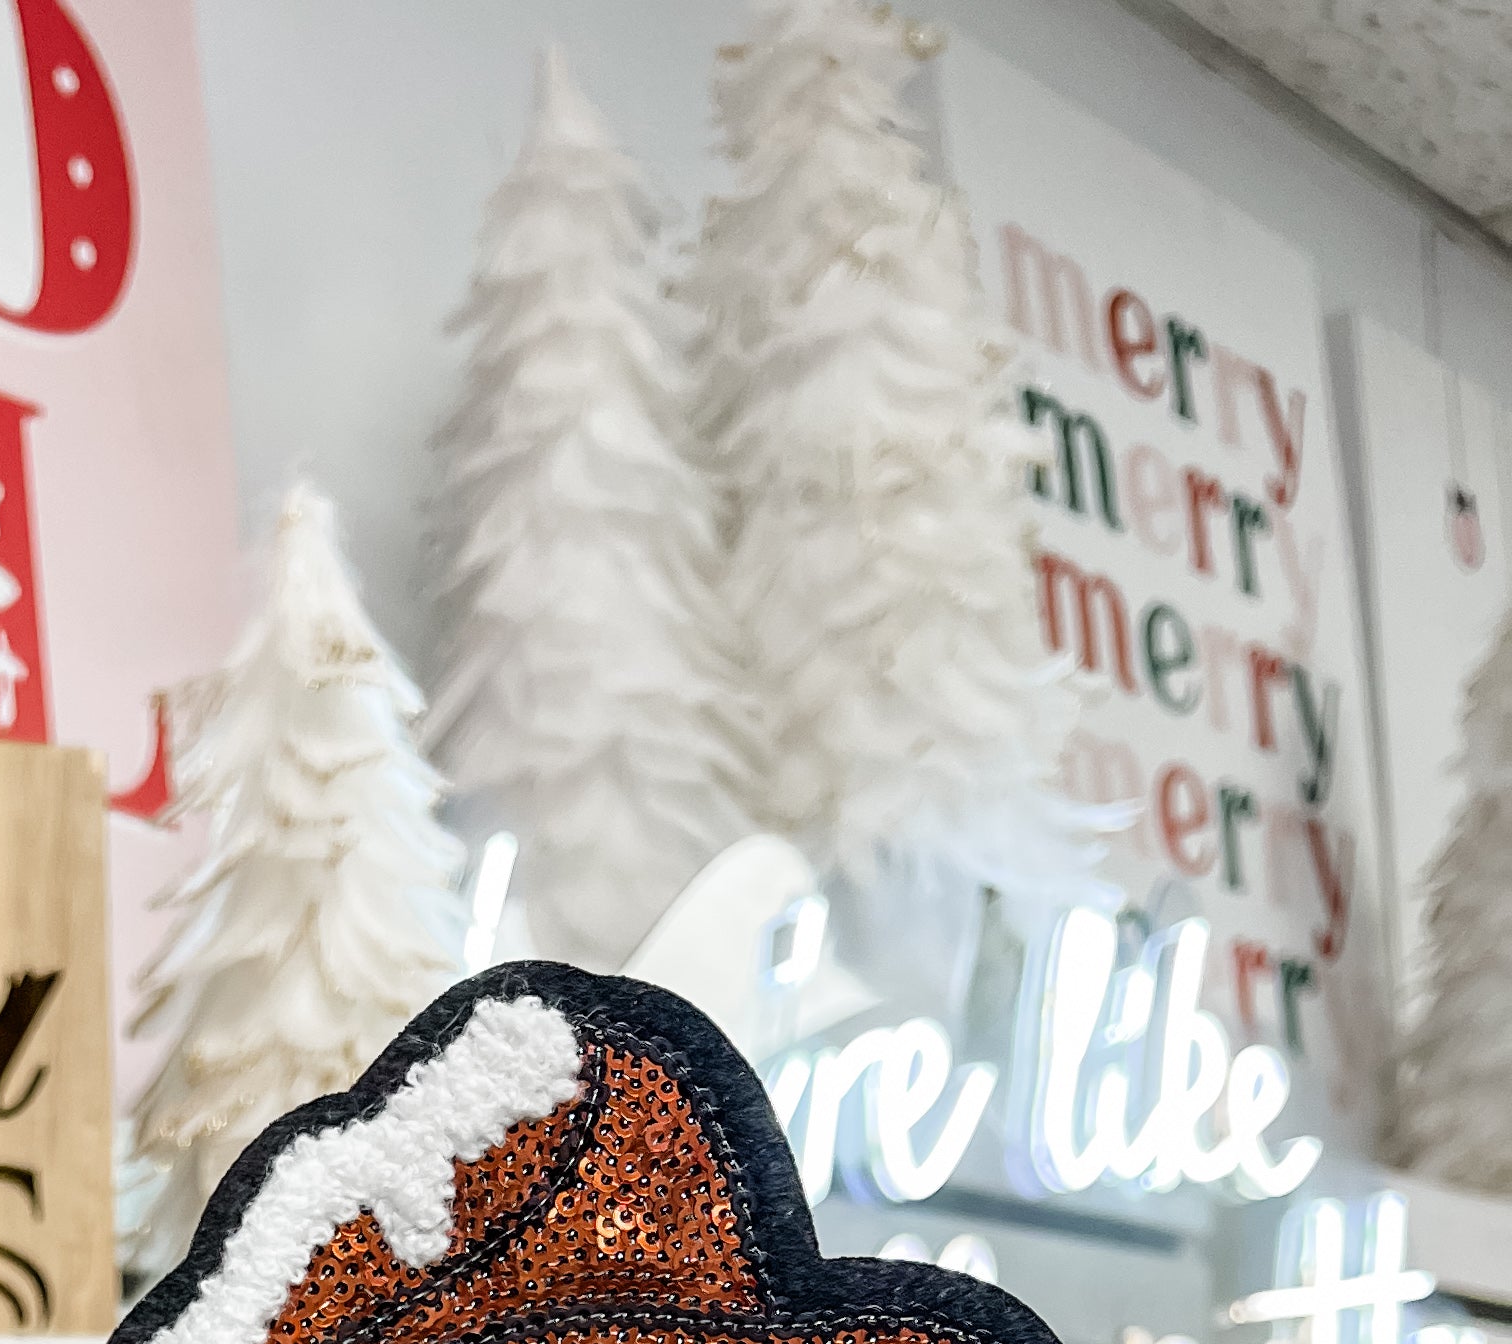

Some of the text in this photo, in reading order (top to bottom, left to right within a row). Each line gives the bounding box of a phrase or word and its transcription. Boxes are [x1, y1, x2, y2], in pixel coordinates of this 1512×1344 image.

[1000, 223, 1307, 512] merry
[1019, 384, 1327, 662] merry
[1035, 553, 1341, 806] merry
[1032, 906, 1324, 1198] like
